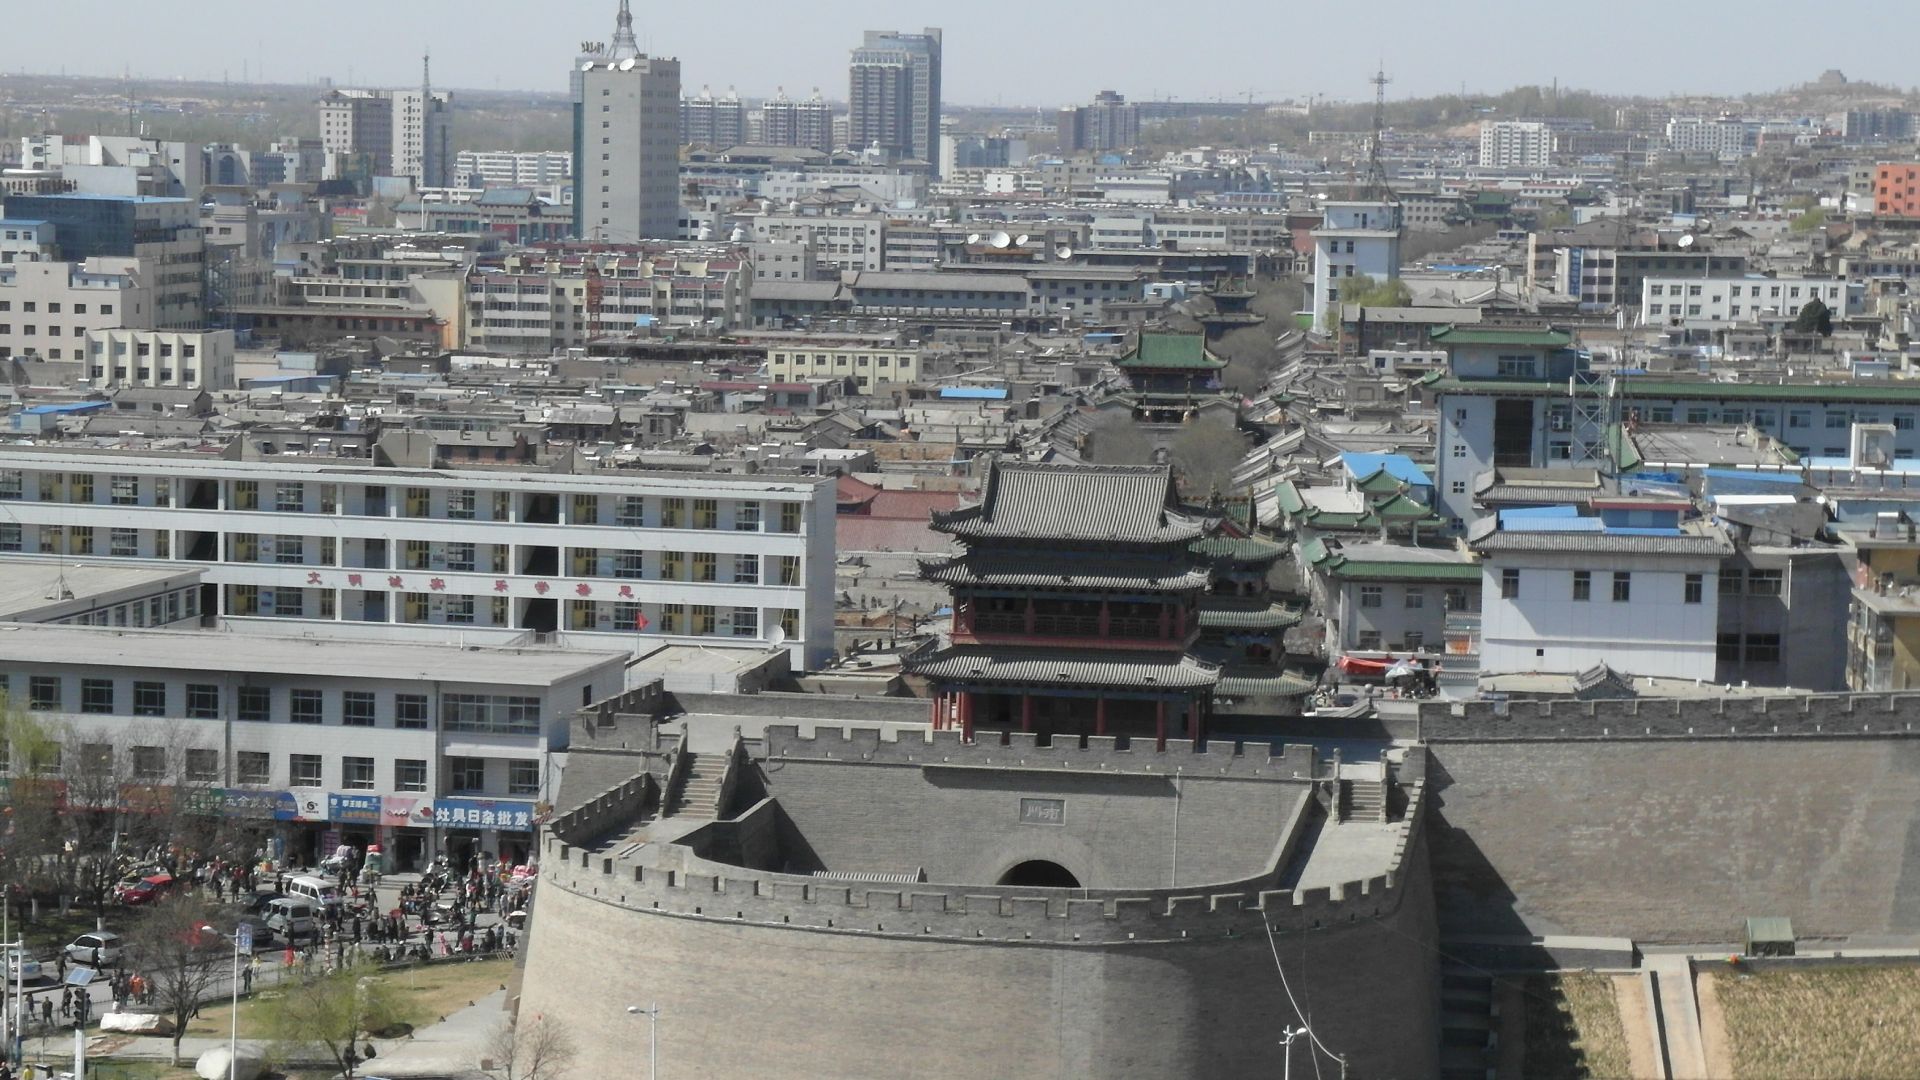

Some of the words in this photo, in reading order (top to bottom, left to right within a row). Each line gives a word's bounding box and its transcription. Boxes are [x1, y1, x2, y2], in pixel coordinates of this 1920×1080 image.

[436, 807, 528, 827] 灶具日杂批发
